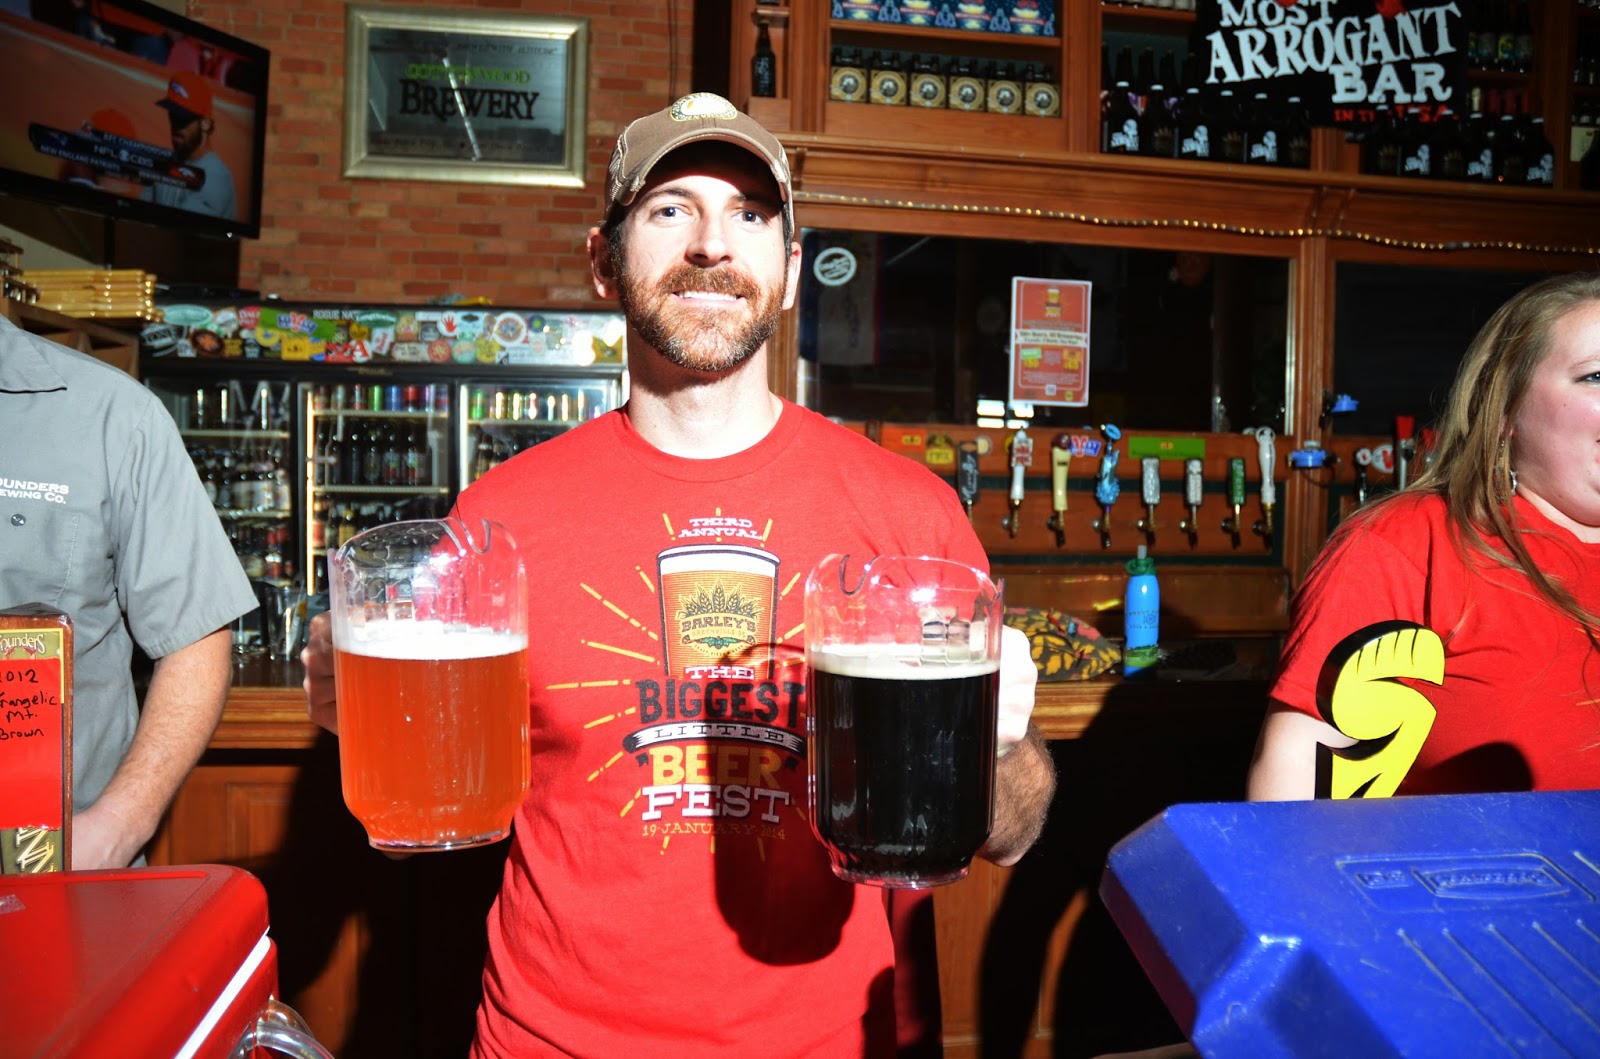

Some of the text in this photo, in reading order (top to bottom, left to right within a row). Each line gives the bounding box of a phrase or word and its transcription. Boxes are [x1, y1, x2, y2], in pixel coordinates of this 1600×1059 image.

[1217, 0, 1337, 27] MOST
[1206, 4, 1461, 84] ARROGANT
[1329, 63, 1452, 103] BAR
[399, 79, 540, 122] BREWERY
[678, 528, 763, 540] ANNUAL
[689, 517, 753, 528] THIRD
[681, 616, 756, 633] BARLEY'S
[685, 666, 755, 680] THE
[635, 679, 806, 729] BIGGEST
[654, 724, 785, 744] LITTLE
[648, 745, 783, 789] BEER
[642, 784, 790, 823] FEST
